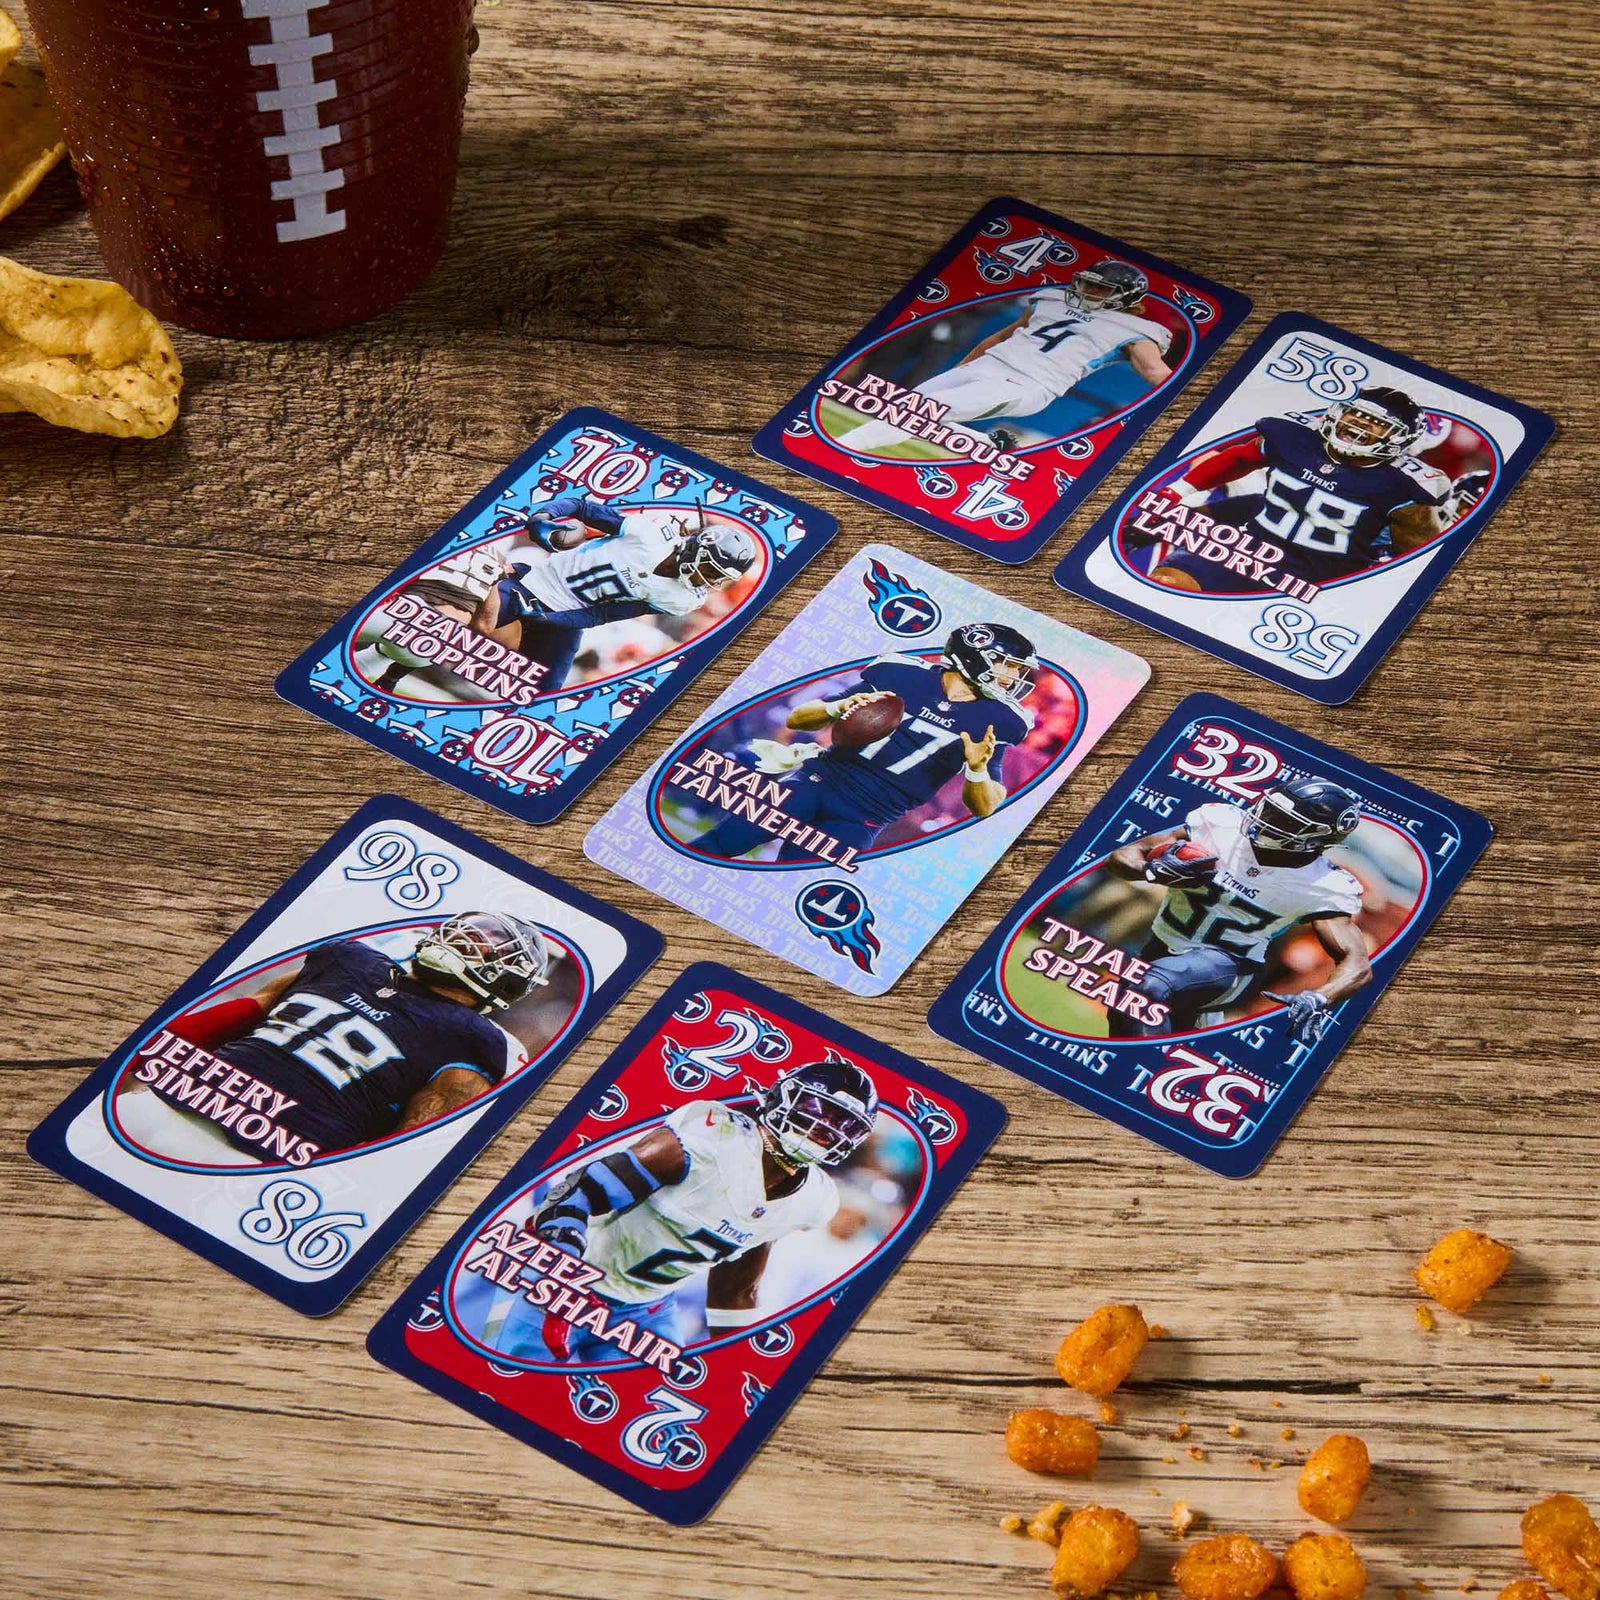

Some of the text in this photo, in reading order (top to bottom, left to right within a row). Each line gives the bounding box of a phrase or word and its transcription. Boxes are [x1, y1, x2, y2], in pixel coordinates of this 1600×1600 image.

[996, 234, 1056, 276] 4
[1030, 319, 1082, 353] 4
[1266, 337, 1369, 402] 58
[817, 379, 1036, 482] STONEHOUSE
[857, 373, 951, 421] RYAN
[556, 434, 652, 498] 10
[952, 474, 1024, 521] 4
[1301, 467, 1339, 491] TITANS
[1138, 491, 1285, 564] HAROLD
[1254, 467, 1370, 554] 58
[1132, 510, 1321, 604] LANDRY III
[382, 621, 540, 706] HOPKINS
[385, 596, 549, 685] DEANDRE
[1250, 603, 1360, 674] 58
[470, 715, 574, 787] 10
[918, 706, 955, 728] TITANS
[692, 748, 792, 807] RYAN
[1171, 724, 1282, 803] 32
[669, 762, 860, 873] TANNEHILL
[344, 831, 460, 911] 98
[1222, 872, 1260, 900] TITANS
[1040, 917, 1151, 984] TYJAE
[1160, 881, 1284, 958] 32
[343, 992, 391, 1022] TITANS
[1025, 948, 1171, 1026] SPEARS
[139, 1029, 298, 1118] JEFFERY
[250, 992, 406, 1091] 98
[684, 1010, 762, 1080] 2
[135, 1058, 320, 1166] SIMMONS
[1147, 1047, 1262, 1138] 32
[240, 1179, 365, 1271] 98
[478, 1220, 605, 1295] AZEEZ
[715, 1219, 754, 1244] TITANS
[465, 1250, 682, 1374] AL-SHAAIR
[620, 1384, 709, 1469] 2
